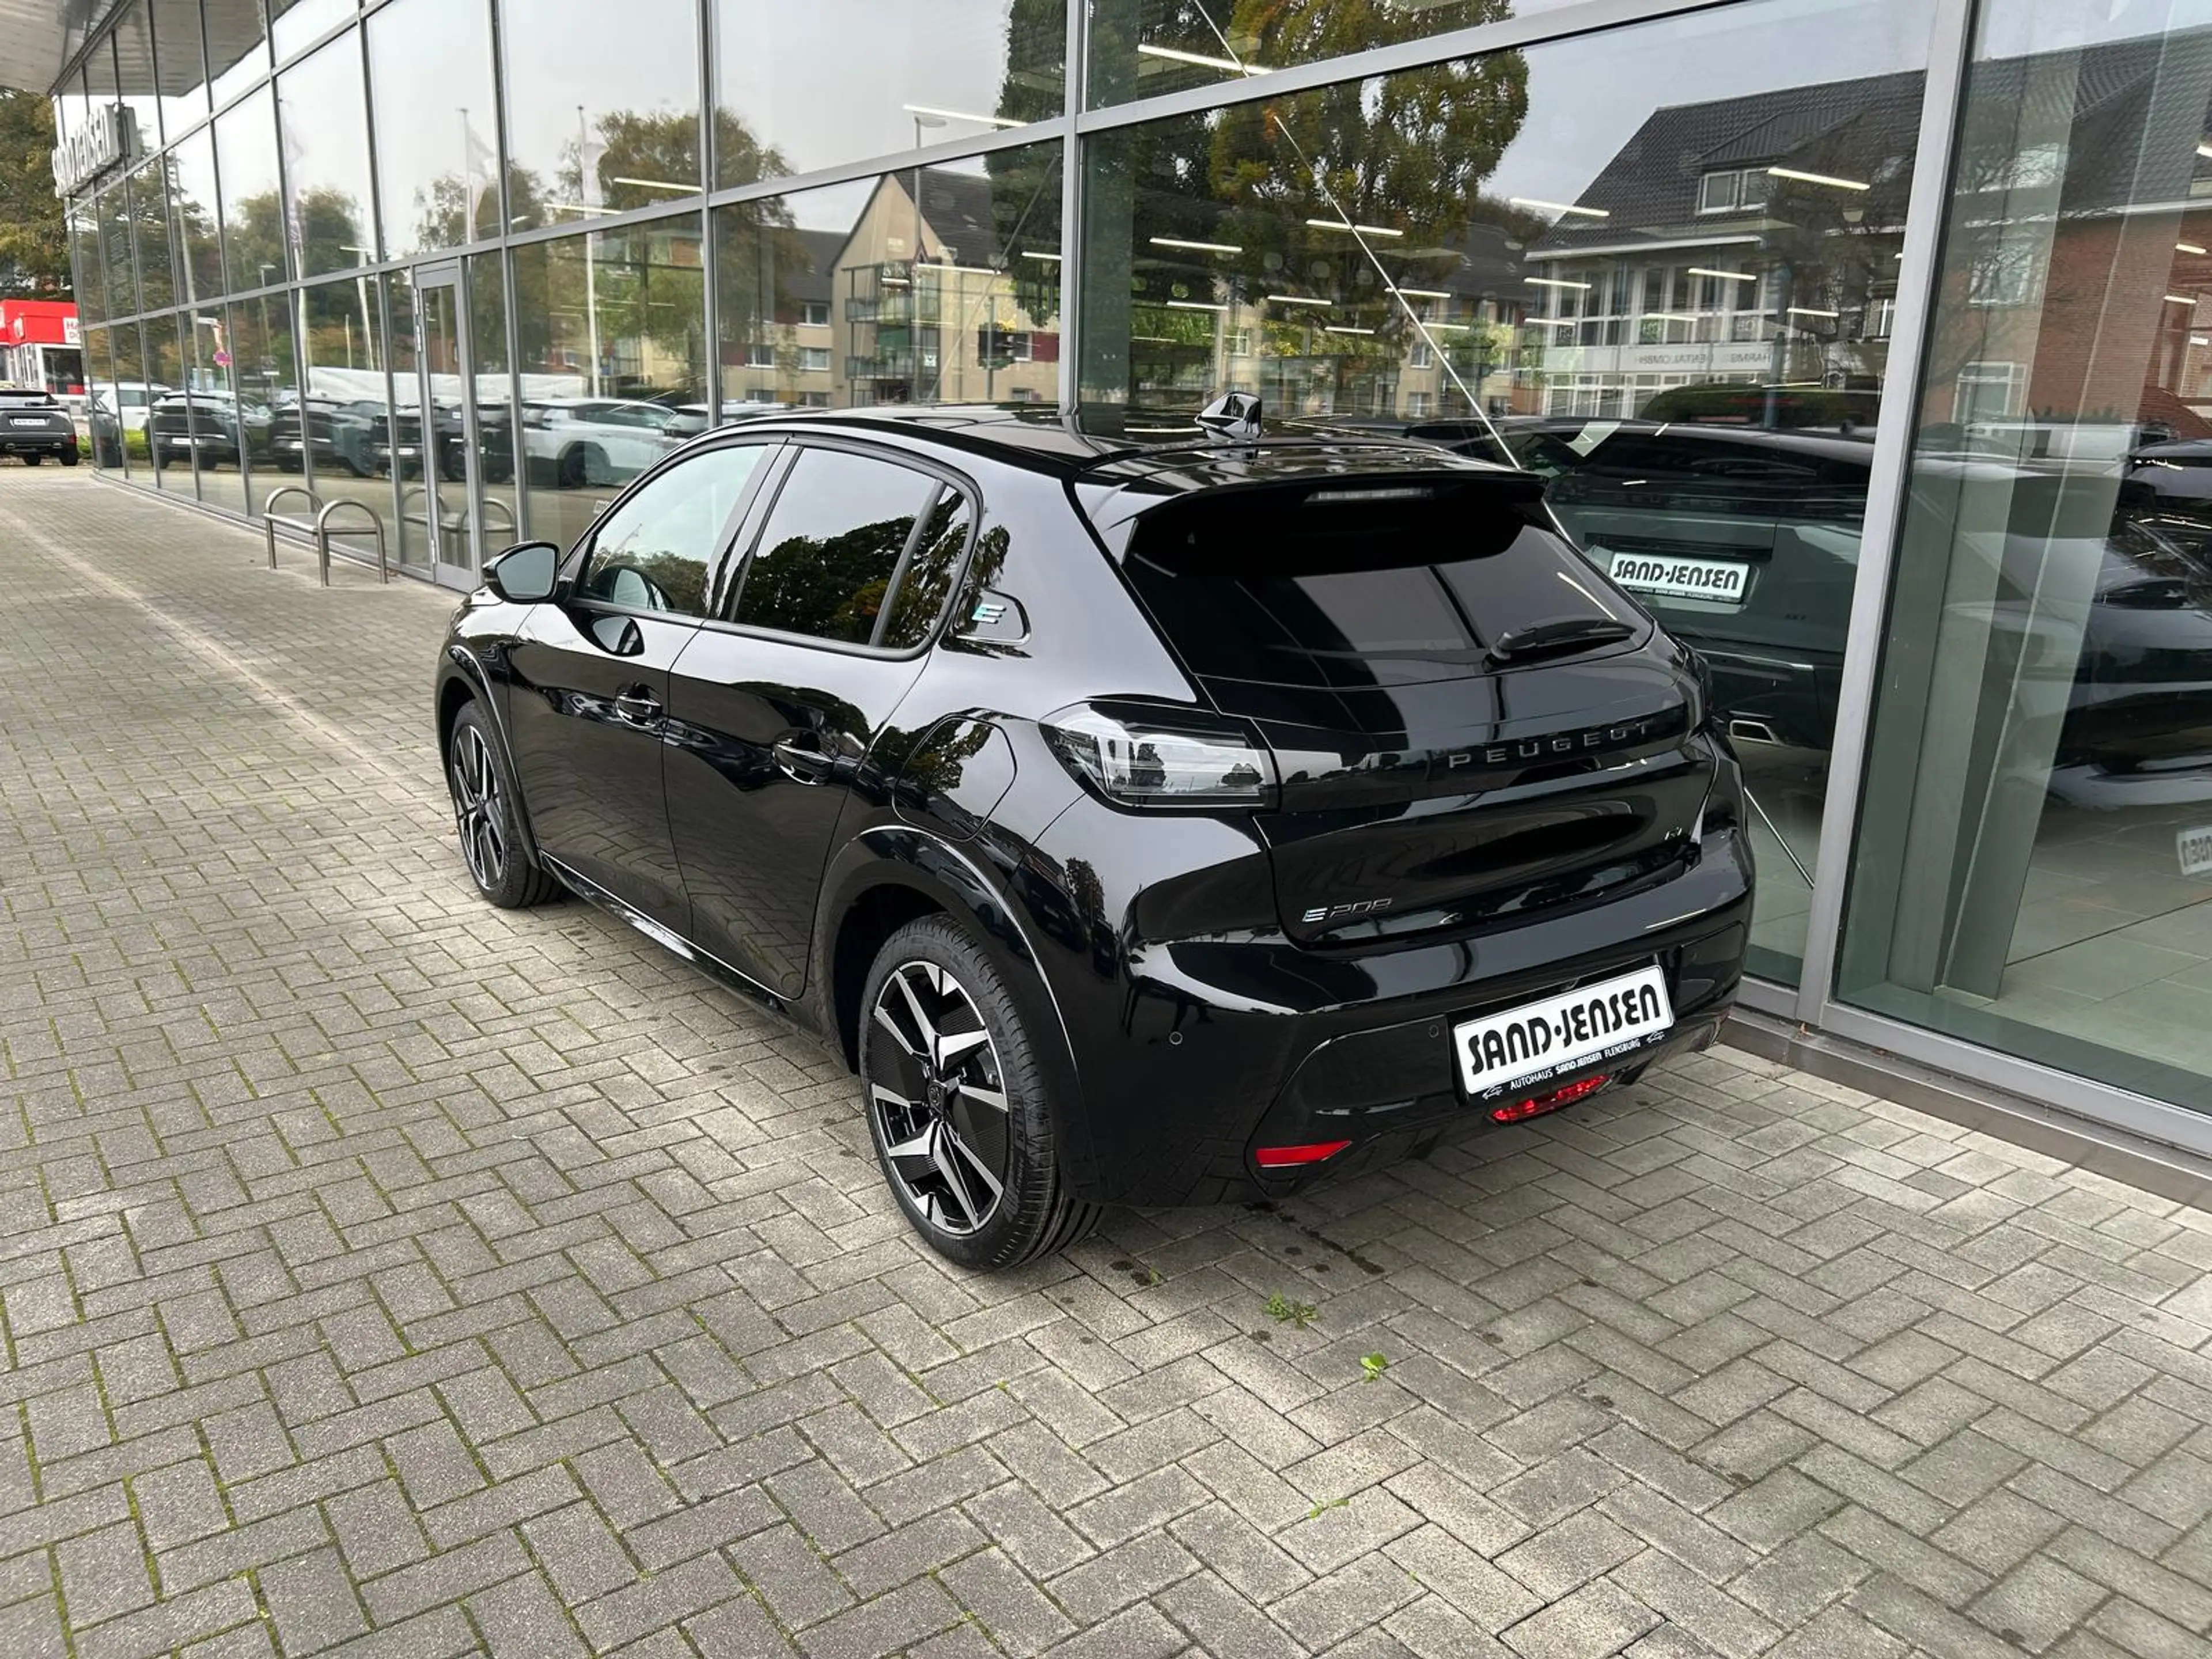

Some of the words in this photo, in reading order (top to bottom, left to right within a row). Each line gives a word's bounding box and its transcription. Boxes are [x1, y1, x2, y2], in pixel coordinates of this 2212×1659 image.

[1448, 722, 1648, 768] PEUGEOT
[1510, 1068, 1554, 1090] AUTOHAUS
[1605, 1038, 1641, 1058] FLENSBURG
